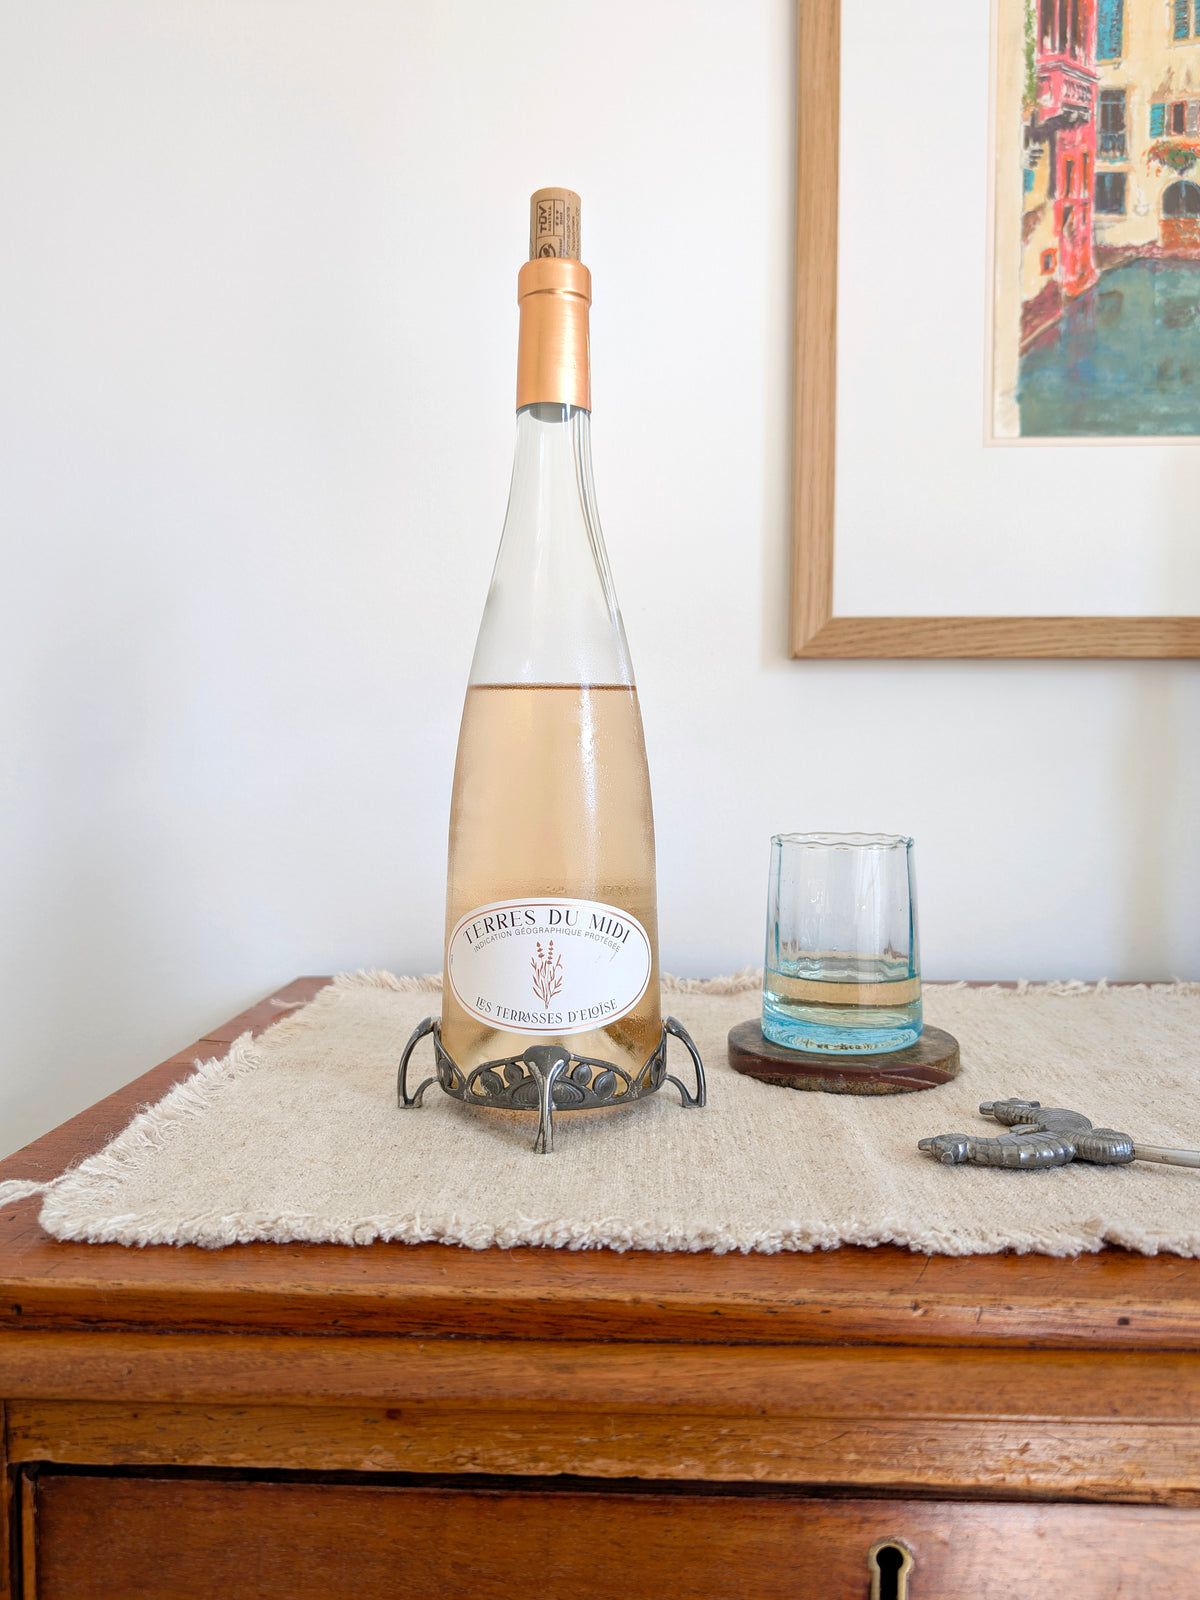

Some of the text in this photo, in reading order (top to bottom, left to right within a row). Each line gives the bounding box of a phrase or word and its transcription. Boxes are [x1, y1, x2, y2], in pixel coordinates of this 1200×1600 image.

[463, 909, 631, 945] TERRES DU MIDI
[473, 926, 621, 953] INDICATION GÉOGRAPHIQUE PROTÉGÉE
[475, 996, 492, 1013] LES
[496, 1005, 562, 1024] TERRASSES
